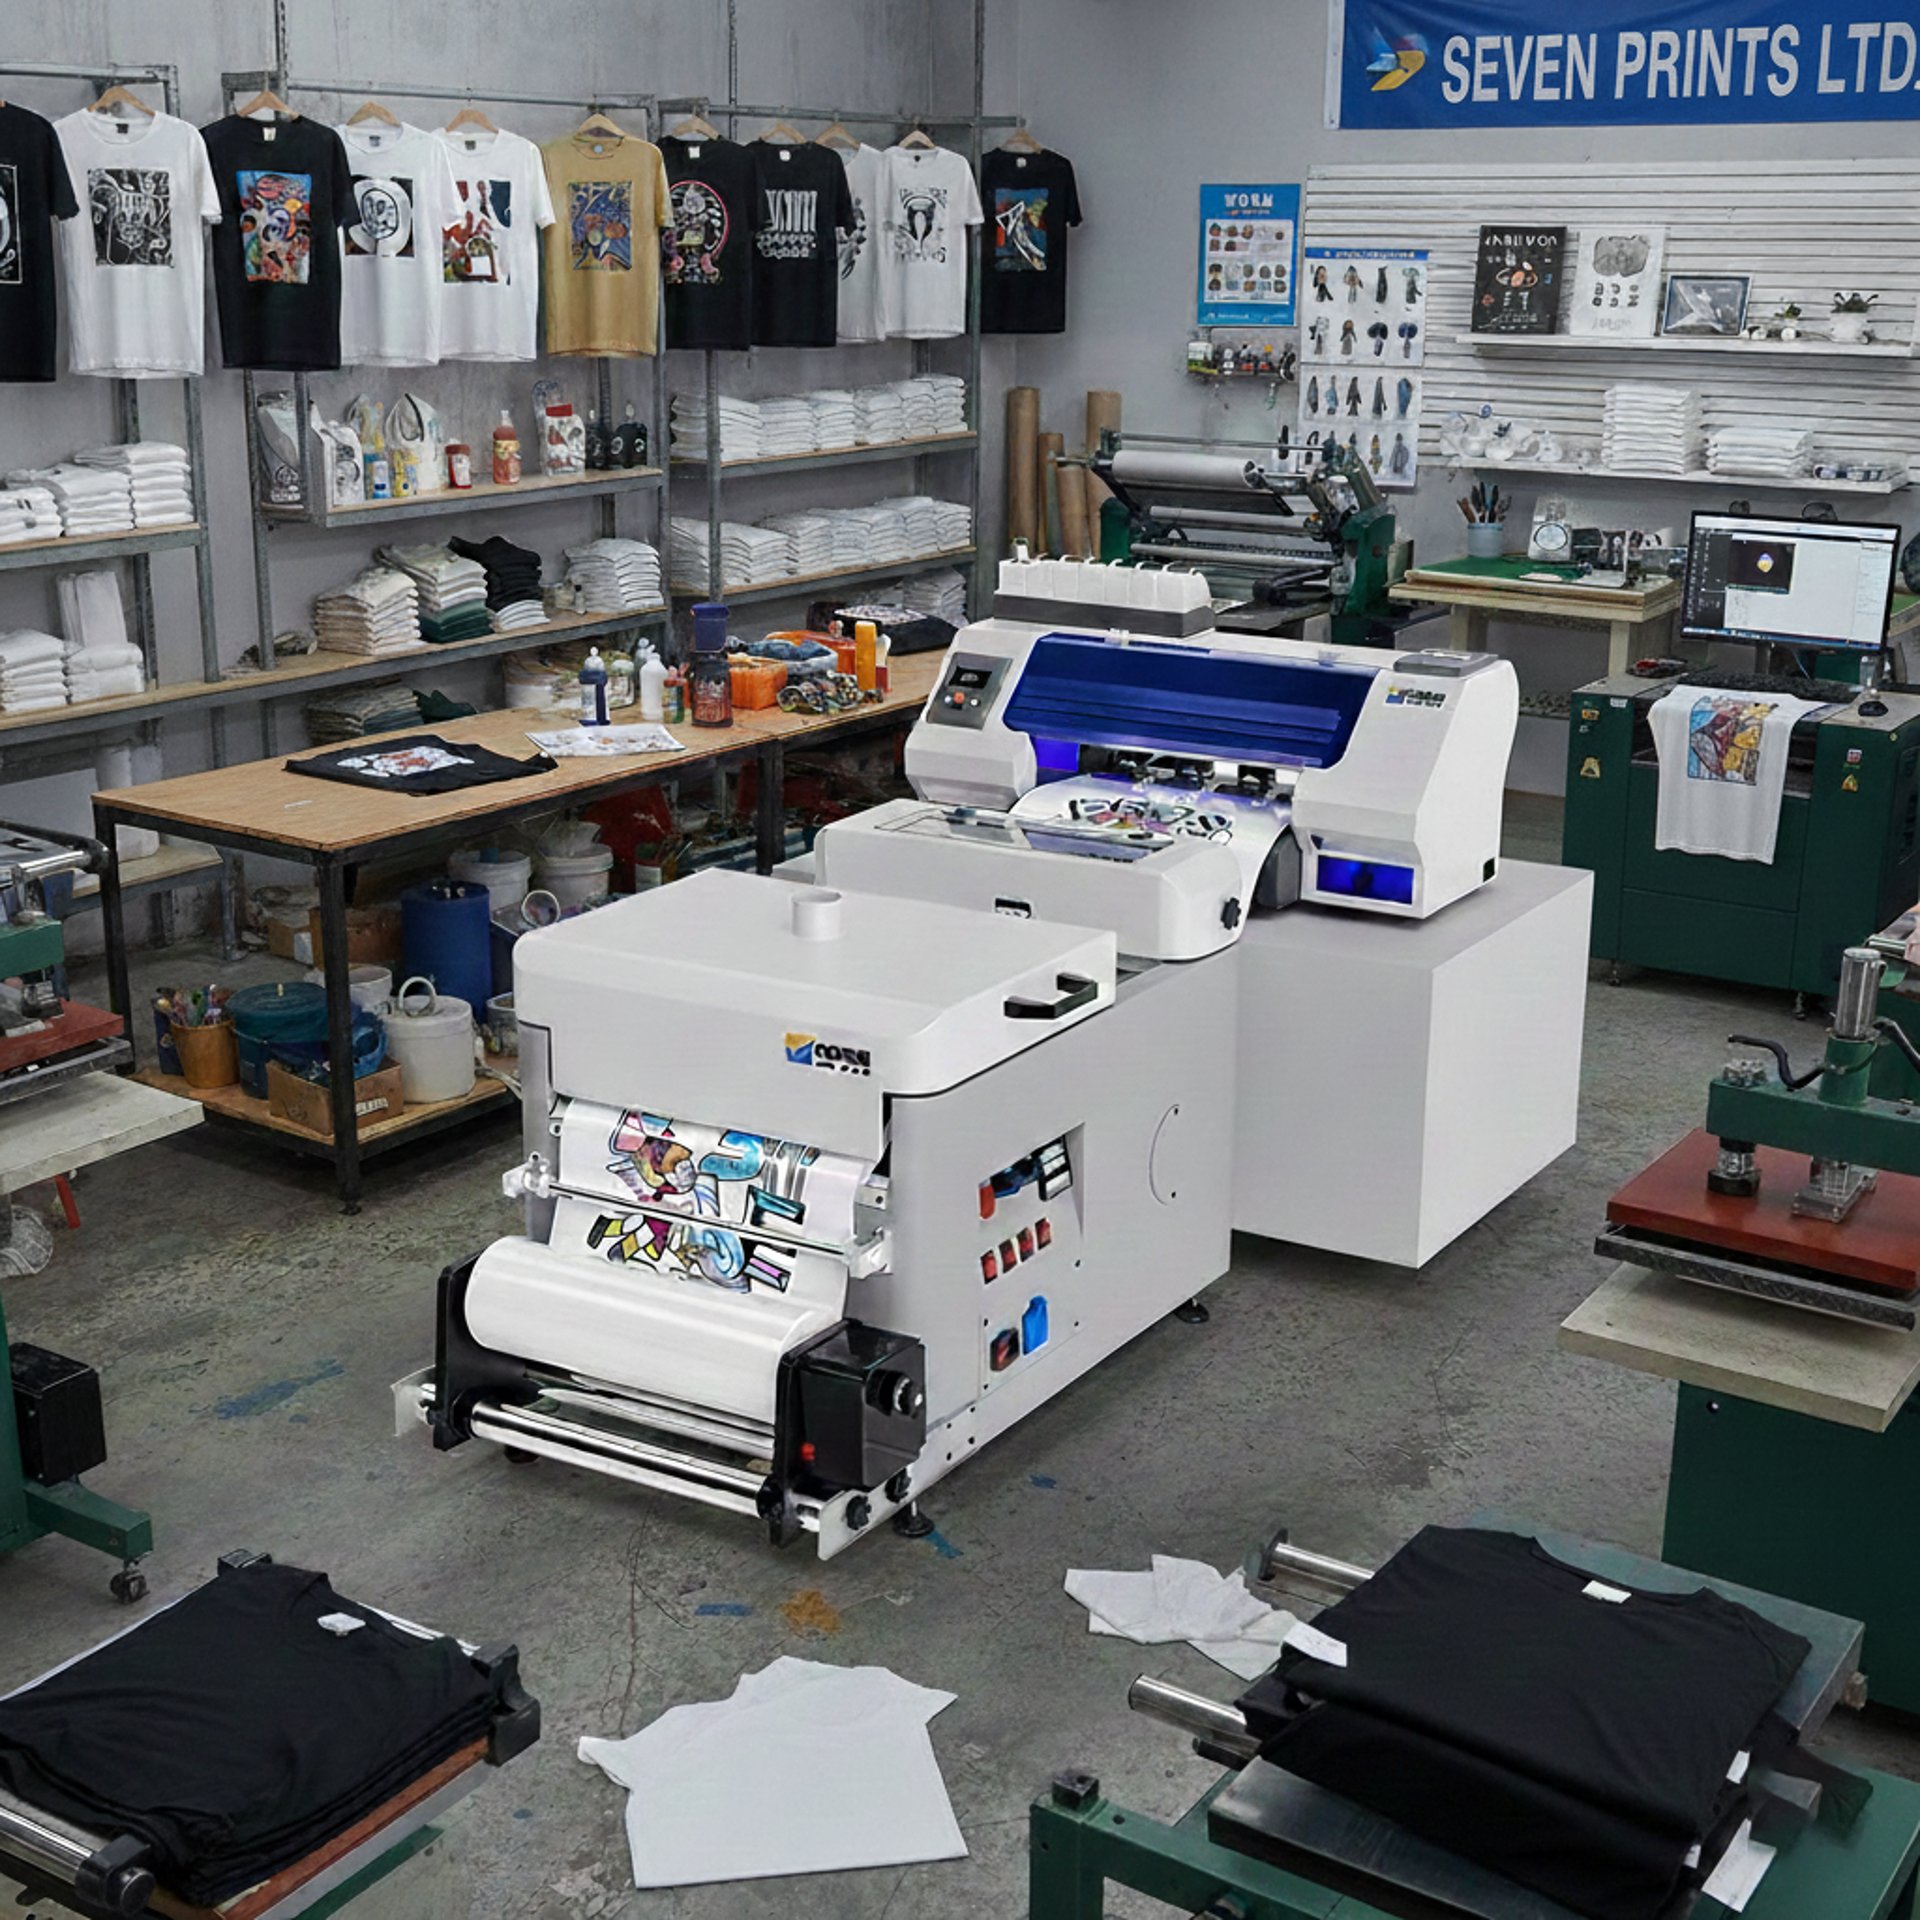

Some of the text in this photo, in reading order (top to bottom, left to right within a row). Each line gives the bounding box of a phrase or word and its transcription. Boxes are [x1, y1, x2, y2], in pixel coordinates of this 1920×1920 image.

[1441, 21, 1920, 104] SEVEN PRINTS LTD.
